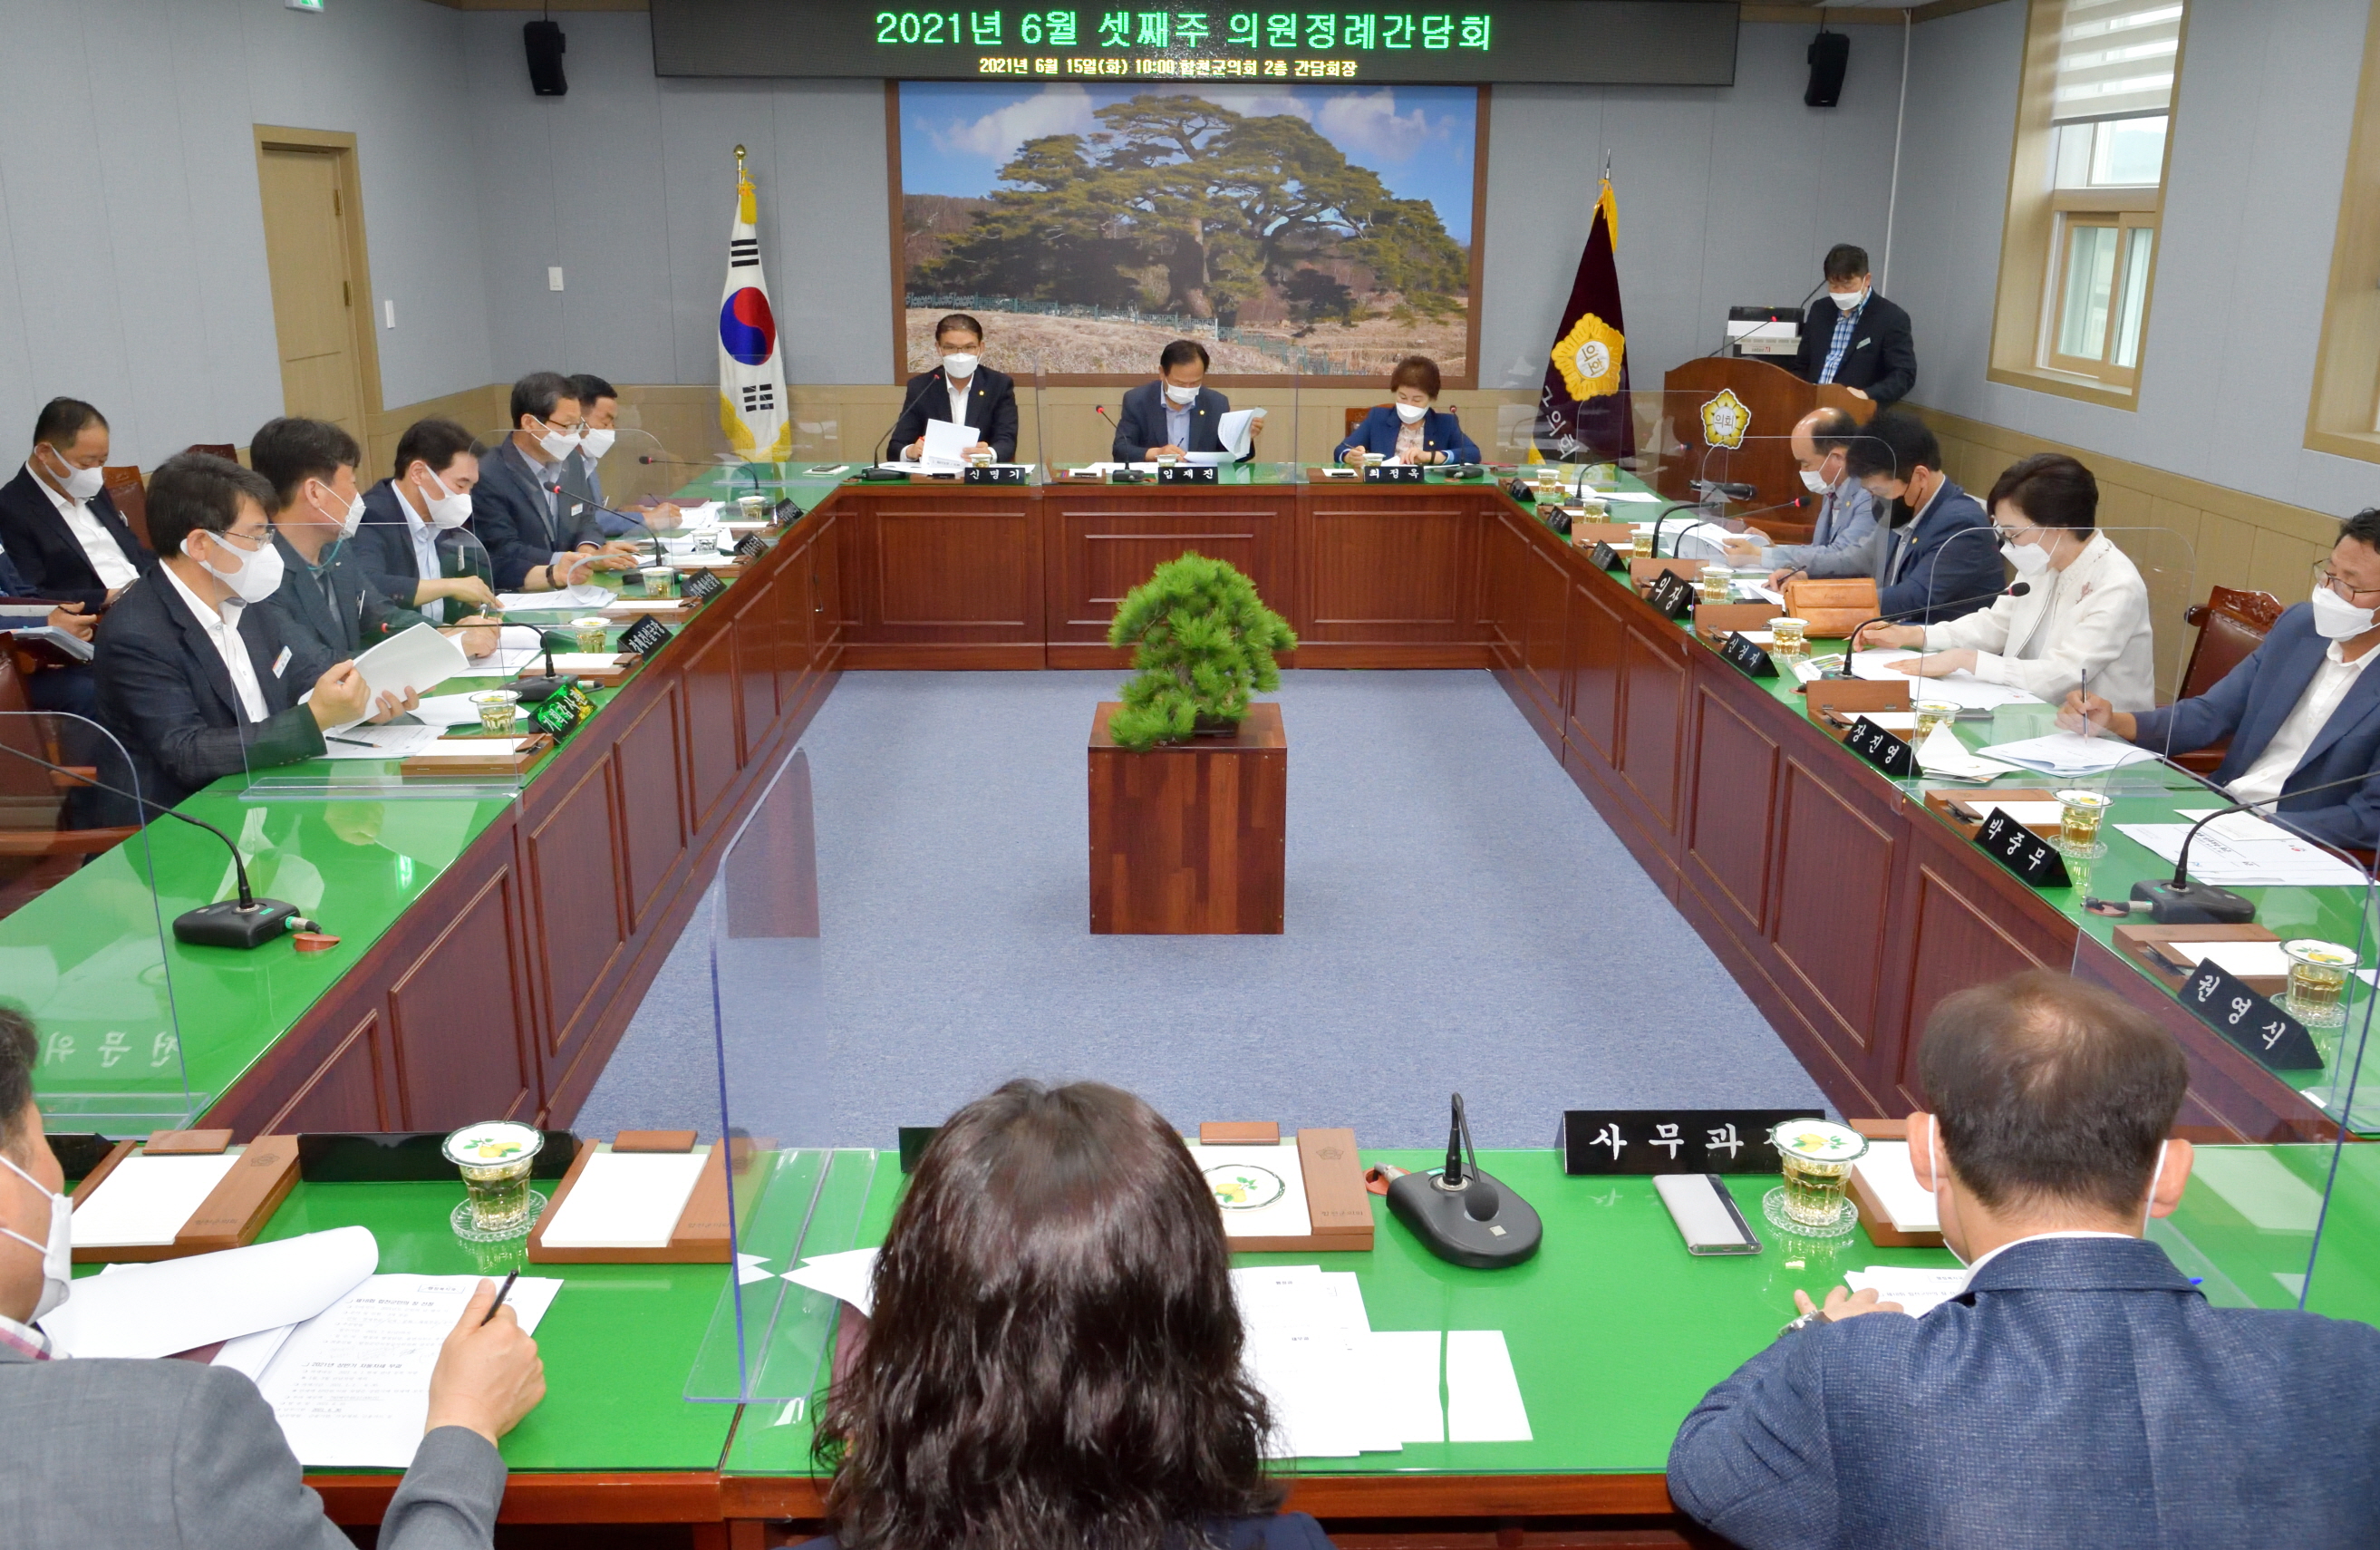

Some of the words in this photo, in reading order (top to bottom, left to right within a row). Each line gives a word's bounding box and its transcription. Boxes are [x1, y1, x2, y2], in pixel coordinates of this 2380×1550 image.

[876, 11, 1001, 45] 2021년
[1021, 11, 1077, 45] 6월
[1098, 12, 1210, 47] 셋째주
[1227, 13, 1491, 51] 의원정례간담회
[979, 58, 1028, 74] 2021년
[1035, 58, 1059, 74] 6월
[1066, 58, 1128, 75] 15일(화)
[1135, 59, 1175, 75] 10:00
[1180, 60, 1257, 76] 합천군의회
[1264, 61, 1288, 76] 2층
[1294, 60, 1358, 77] 간담회장
[1582, 344, 1605, 376] 의회
[1714, 413, 1734, 429] 의회
[1654, 576, 1684, 612] 의장
[628, 619, 665, 654] 경제건설국장
[1727, 637, 1760, 668] 신경자
[543, 689, 588, 731] 기획감사관
[1853, 723, 1900, 764] 장진영
[1988, 819, 2046, 871] 박중무
[2198, 974, 2286, 1051] 권영식
[1589, 1122, 1774, 1161] 사무과
